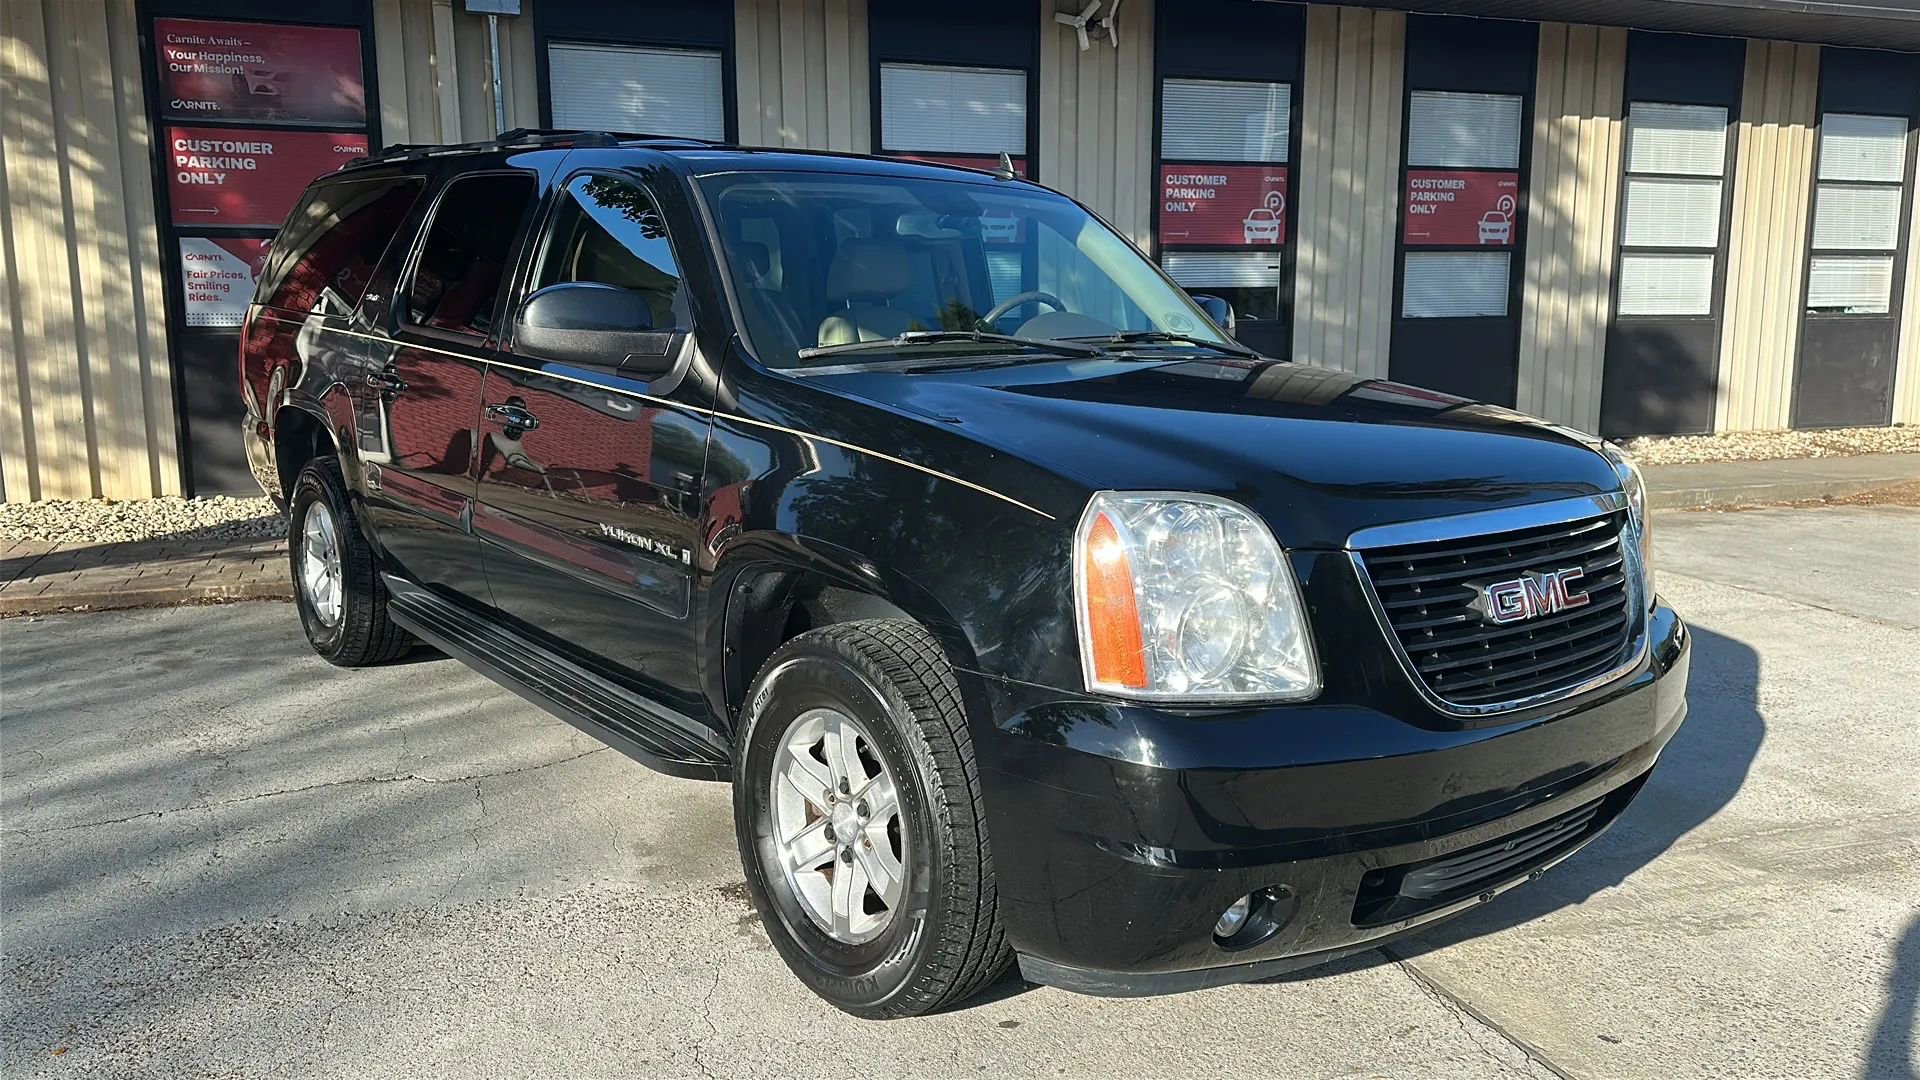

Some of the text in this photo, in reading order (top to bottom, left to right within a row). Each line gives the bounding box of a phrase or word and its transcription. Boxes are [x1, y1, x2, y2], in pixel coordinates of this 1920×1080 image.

[167, 34, 206, 45] Carnite
[208, 36, 242, 46] Awaits
[168, 49, 265, 64] Your Happiness,
[169, 63, 244, 75] Our Mission!
[174, 139, 273, 155] CUSTOMER
[175, 155, 256, 170] PARKING
[177, 172, 226, 185] ONLY
[1166, 174, 1228, 185] CUSTOMER
[1411, 179, 1465, 189] CUSTOMER
[1165, 188, 1216, 199] PARKING
[1410, 192, 1455, 201] PARKING
[1165, 202, 1196, 212] ONLY
[1410, 204, 1438, 214] ONLY
[186, 270, 208, 279] Fair
[187, 281, 230, 293] Smiling
[600, 522, 678, 560] YUKON XL
[1484, 566, 1591, 625] GMC
